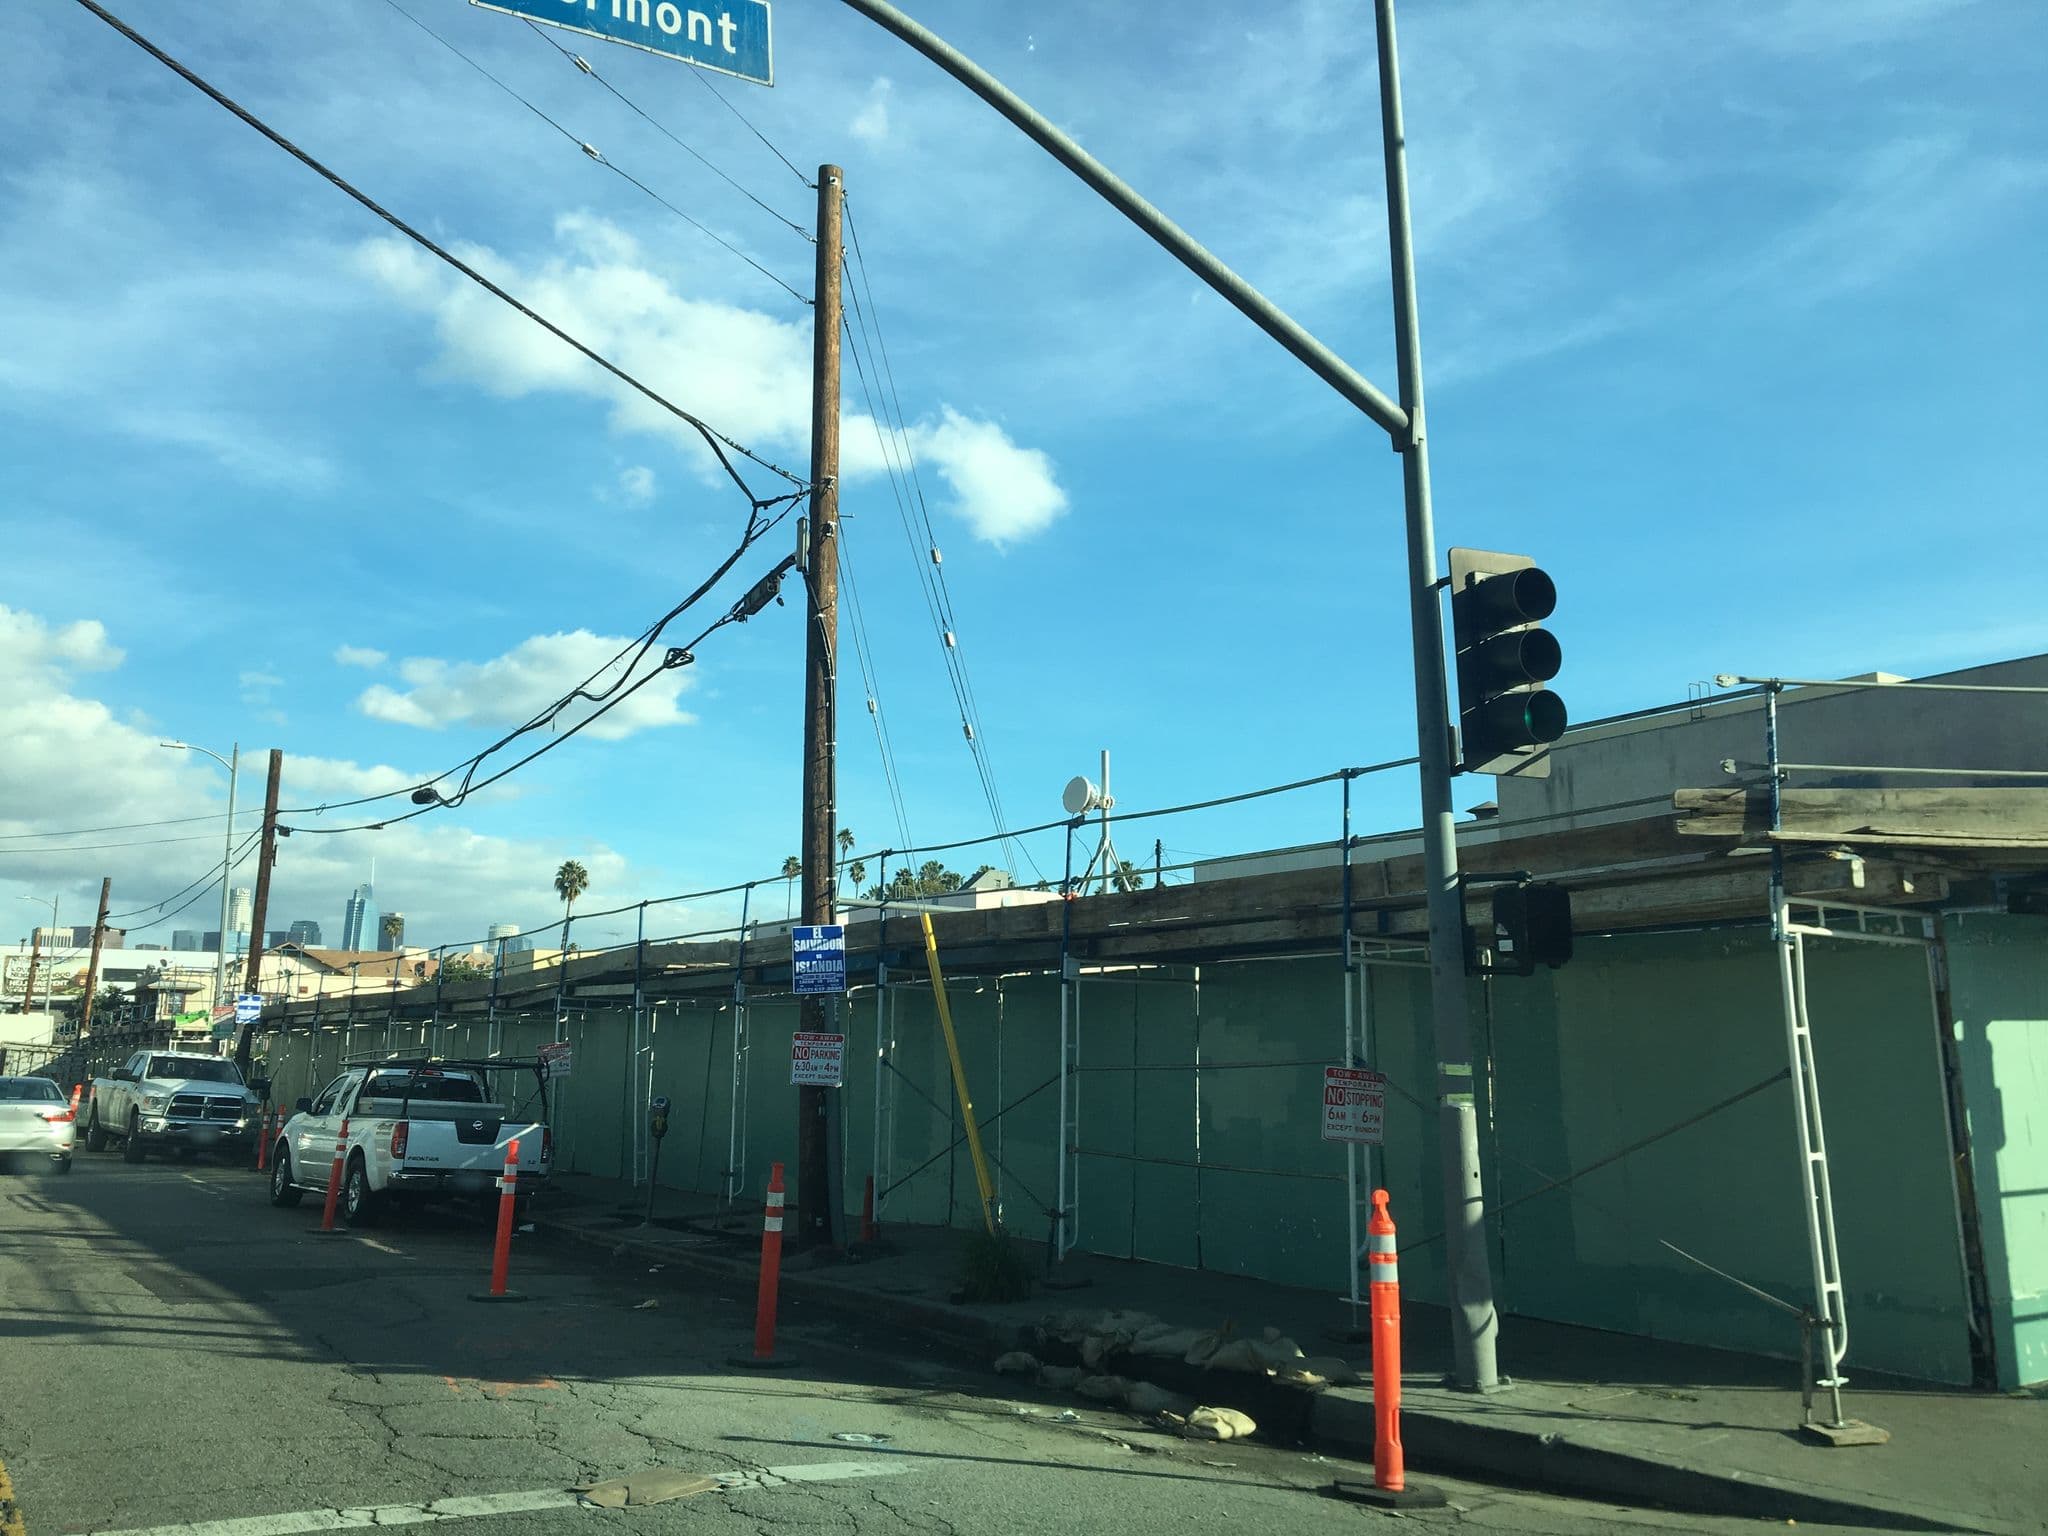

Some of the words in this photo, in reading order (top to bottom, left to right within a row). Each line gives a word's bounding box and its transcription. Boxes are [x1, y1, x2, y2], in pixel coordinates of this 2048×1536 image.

[558, 0, 737, 54] mont
[813, 927, 823, 938] EL
[794, 938, 843, 952] SALVADOR
[795, 960, 843, 973] ISLANDIA
[795, 1047, 809, 1059] NO
[811, 1049, 840, 1061] PARKING
[1327, 1087, 1344, 1105] NO
[1346, 1092, 1383, 1108] STOPPING
[1328, 1106, 1346, 1120] 6AM
[1362, 1110, 1381, 1124] 6PM
